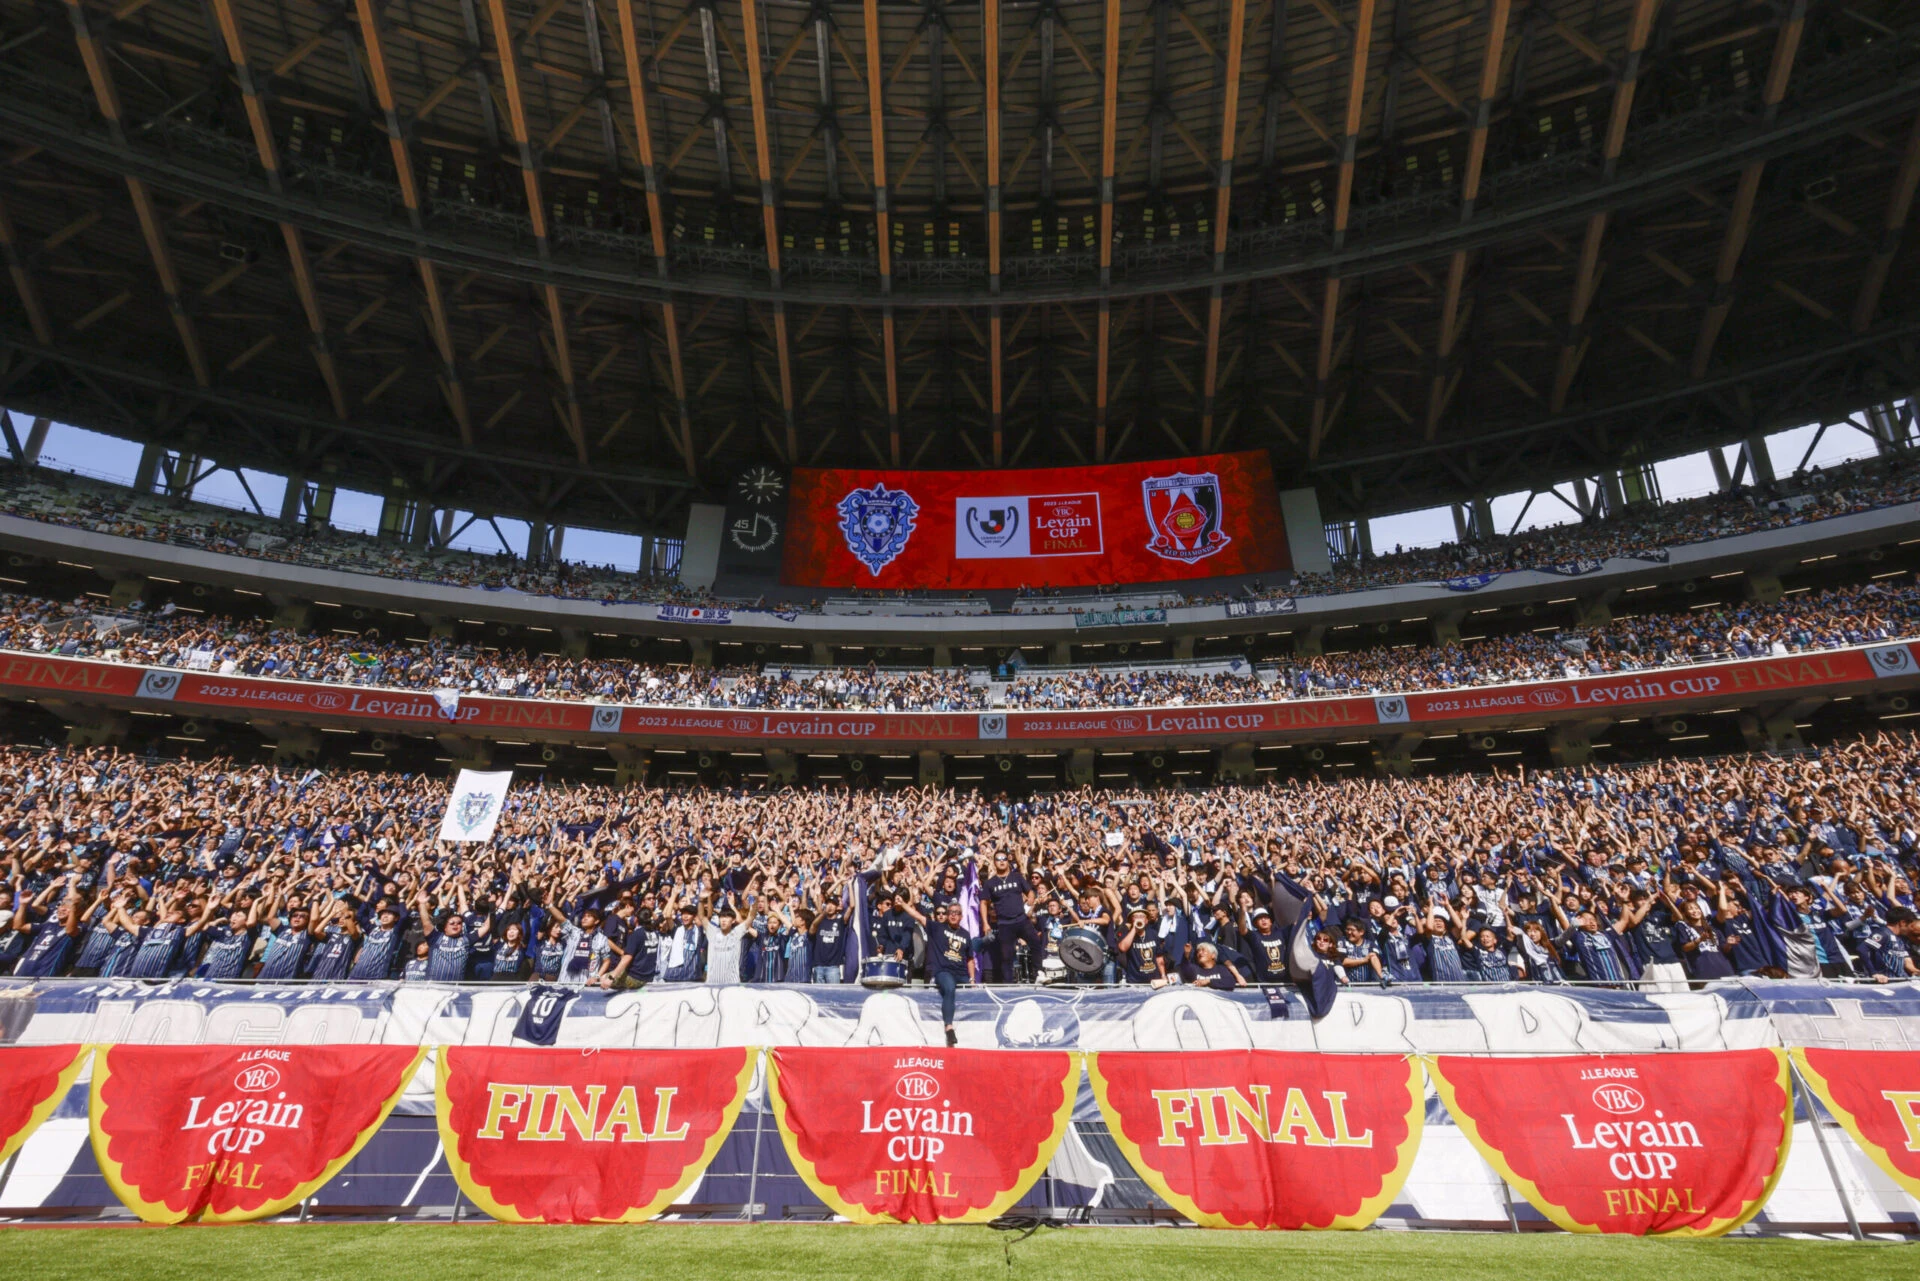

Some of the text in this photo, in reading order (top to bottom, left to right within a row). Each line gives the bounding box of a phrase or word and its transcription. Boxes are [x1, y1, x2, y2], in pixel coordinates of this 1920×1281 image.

[734, 519, 749, 529] 45
[1036, 515, 1092, 528] Levain
[1049, 528, 1079, 538] CUP
[1044, 539, 1087, 549] FINAL
[2, 660, 113, 689] FINAL
[1427, 701, 1460, 712] 2023
[1464, 695, 1526, 709] J.LEAGUE
[1570, 678, 1665, 704] Levain
[1670, 676, 1721, 695] CUP
[1730, 659, 1847, 689] FINAL
[200, 685, 237, 697] 2023
[240, 689, 306, 704] J.LEAGUE
[348, 693, 432, 717] Levain
[488, 704, 573, 726] FINAL
[1023, 721, 1052, 731] 2023
[1054, 720, 1108, 730] J.LEAGUE
[1146, 711, 1220, 731] Levain
[1224, 713, 1264, 729] CUP
[1273, 704, 1359, 726] FINAL
[638, 716, 668, 727] 2023
[670, 717, 724, 728] J.LEAGUE
[761, 716, 834, 735] Levain
[837, 722, 876, 736] CUP
[884, 718, 961, 736] FINAL
[531, 995, 558, 1017] 10
[237, 1049, 291, 1062] J.LEAGUE
[894, 1057, 944, 1070] J.LEAGUE
[244, 1069, 275, 1089] YBC
[1580, 1066, 1639, 1080] J.LEAGUE
[903, 1078, 933, 1097] YBC
[1599, 1089, 1639, 1110] YBC
[181, 1091, 304, 1132] Levain
[477, 1082, 691, 1143] FINAL
[860, 1099, 975, 1137] Levain
[1150, 1085, 1374, 1148] FINAL
[207, 1127, 266, 1155] CUP
[1560, 1109, 1704, 1150] Levain
[887, 1135, 945, 1163] CUP
[181, 1160, 264, 1191] FINAL
[1608, 1151, 1678, 1181] CUP
[874, 1168, 960, 1199] FINAL
[1602, 1187, 1707, 1217] FINAL
